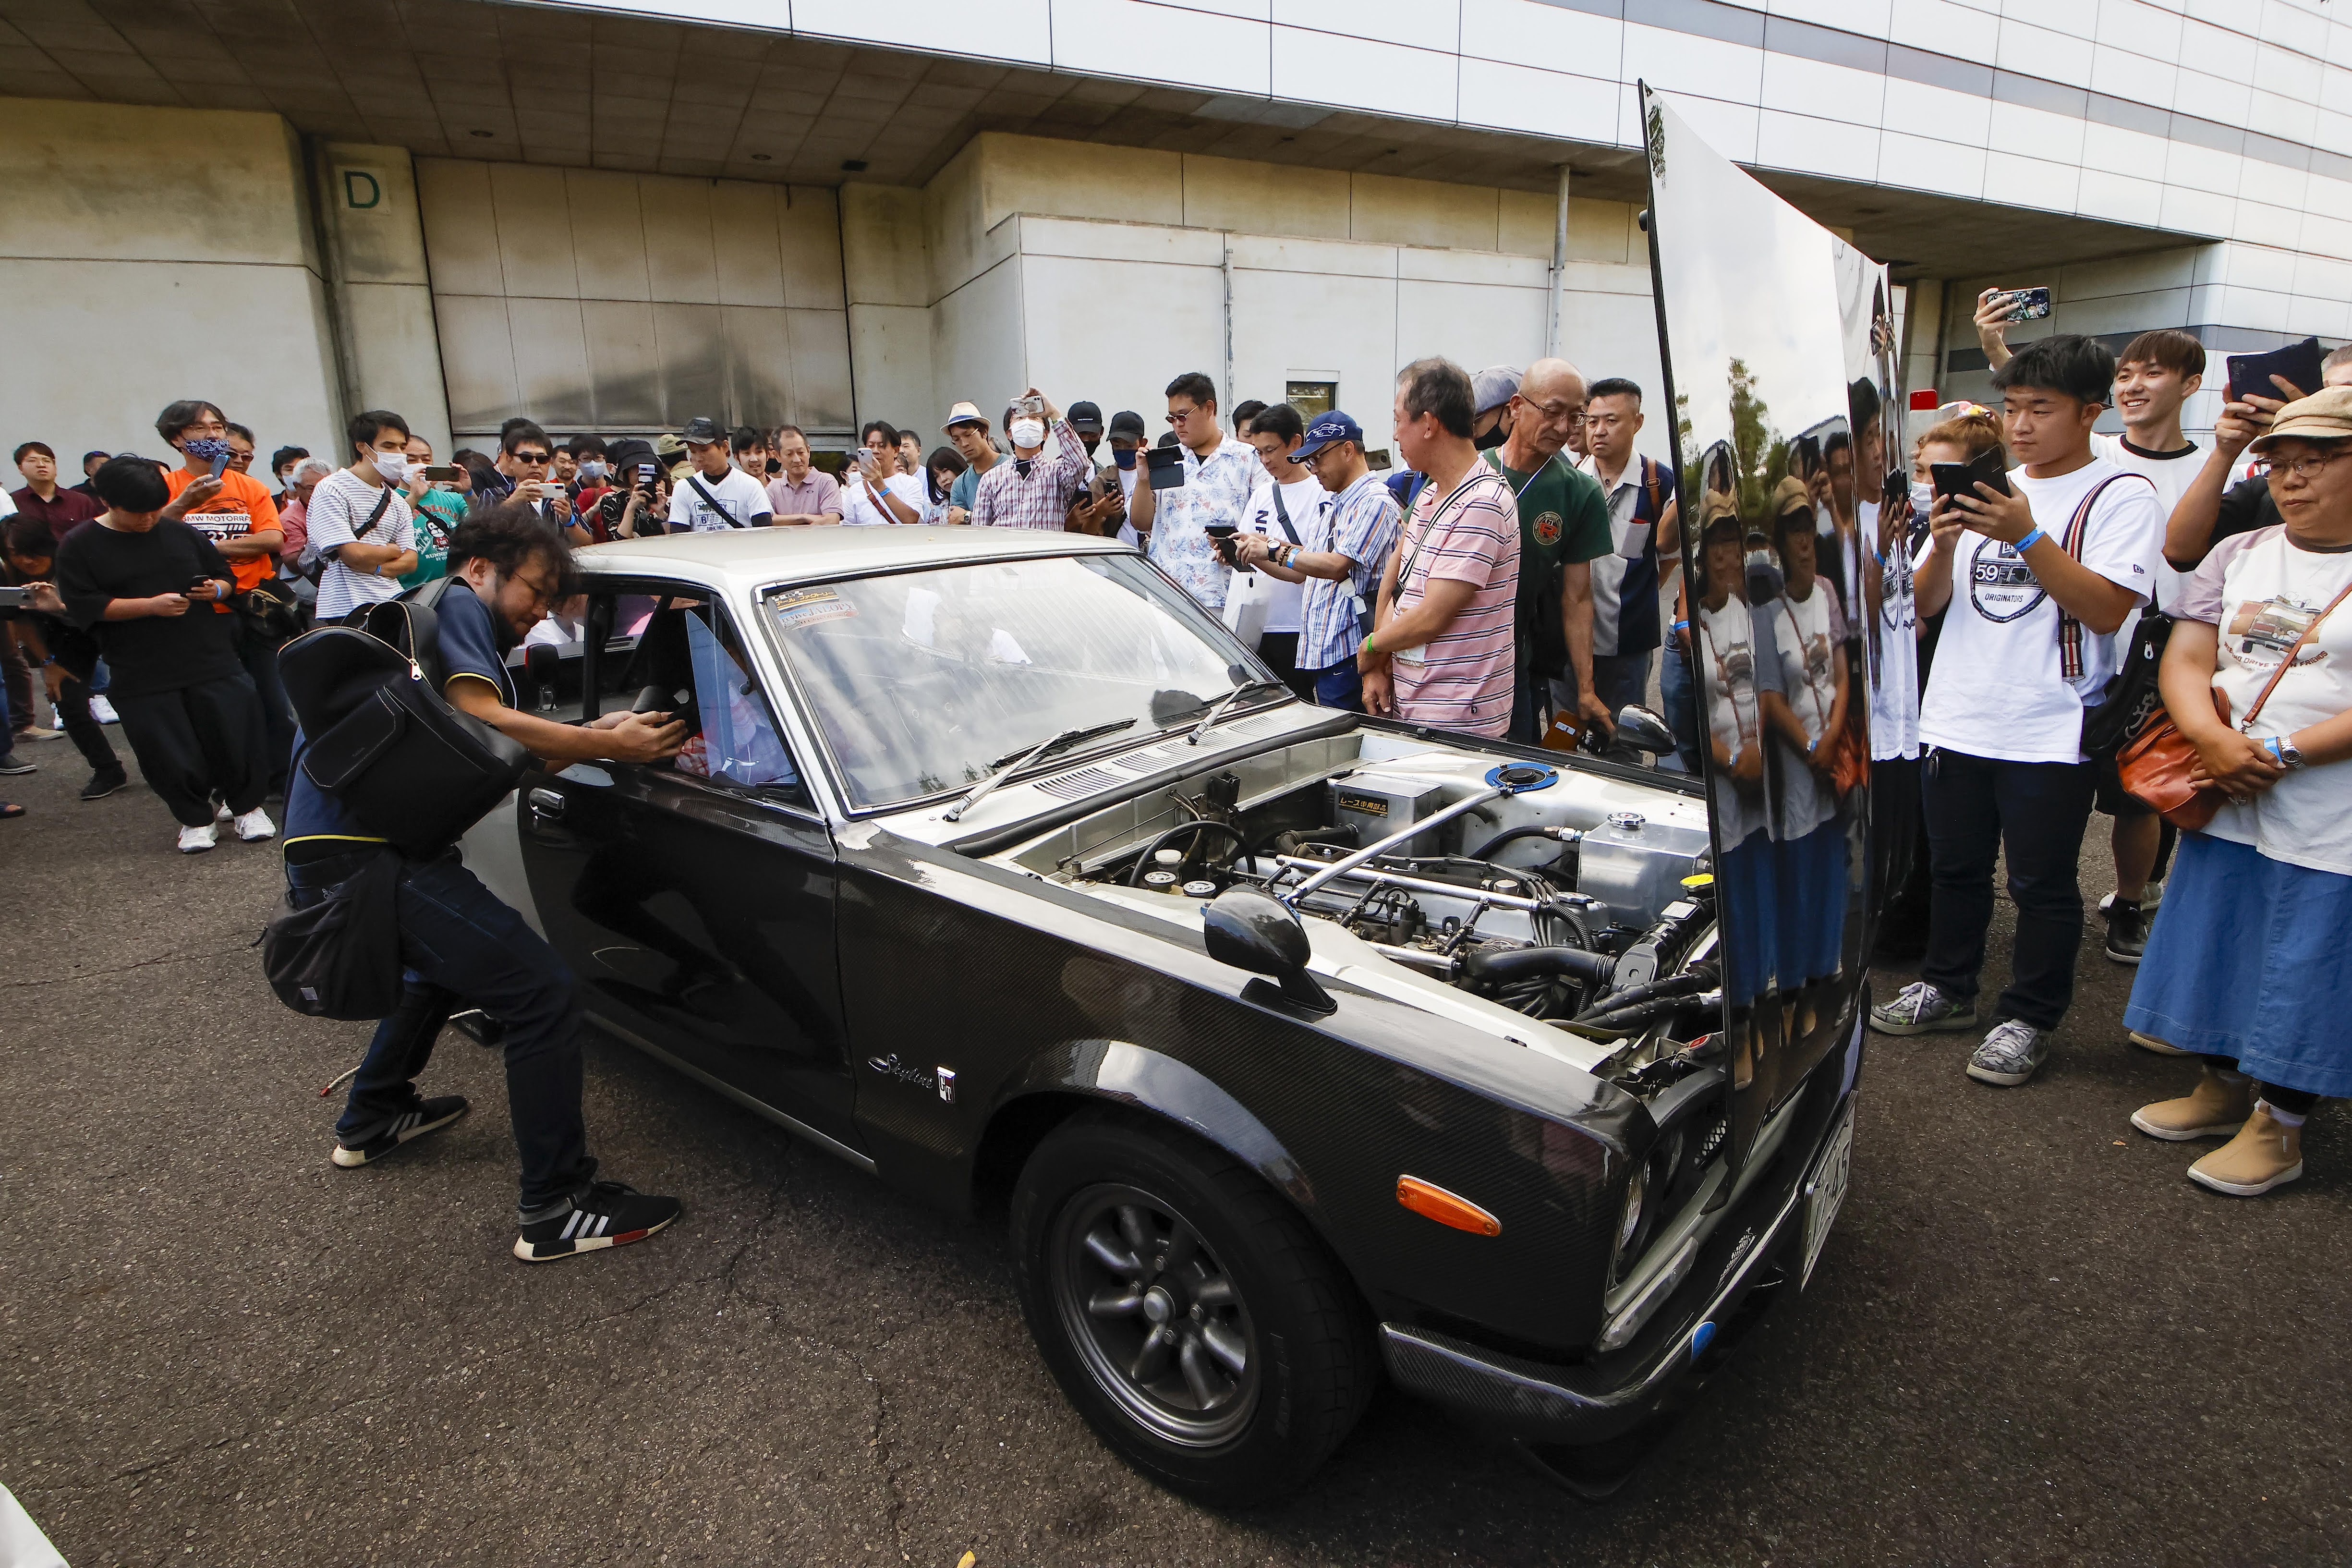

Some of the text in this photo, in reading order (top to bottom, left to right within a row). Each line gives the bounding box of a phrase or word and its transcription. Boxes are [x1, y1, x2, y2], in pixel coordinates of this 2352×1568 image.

[344, 171, 380, 208] D
[701, 516, 707, 524] B
[797, 591, 834, 600] ファクトリー
[1985, 593, 2024, 603] ORIGINATORS
[782, 612, 807, 623] revive
[809, 602, 852, 616] JALOPY
[2243, 658, 2270, 668] DRIVE
[2299, 650, 2328, 668] FRIENDS
[1340, 797, 1386, 812] レース専用部品
[868, 1052, 934, 1089] Skyline
[939, 1075, 952, 1101] GT
